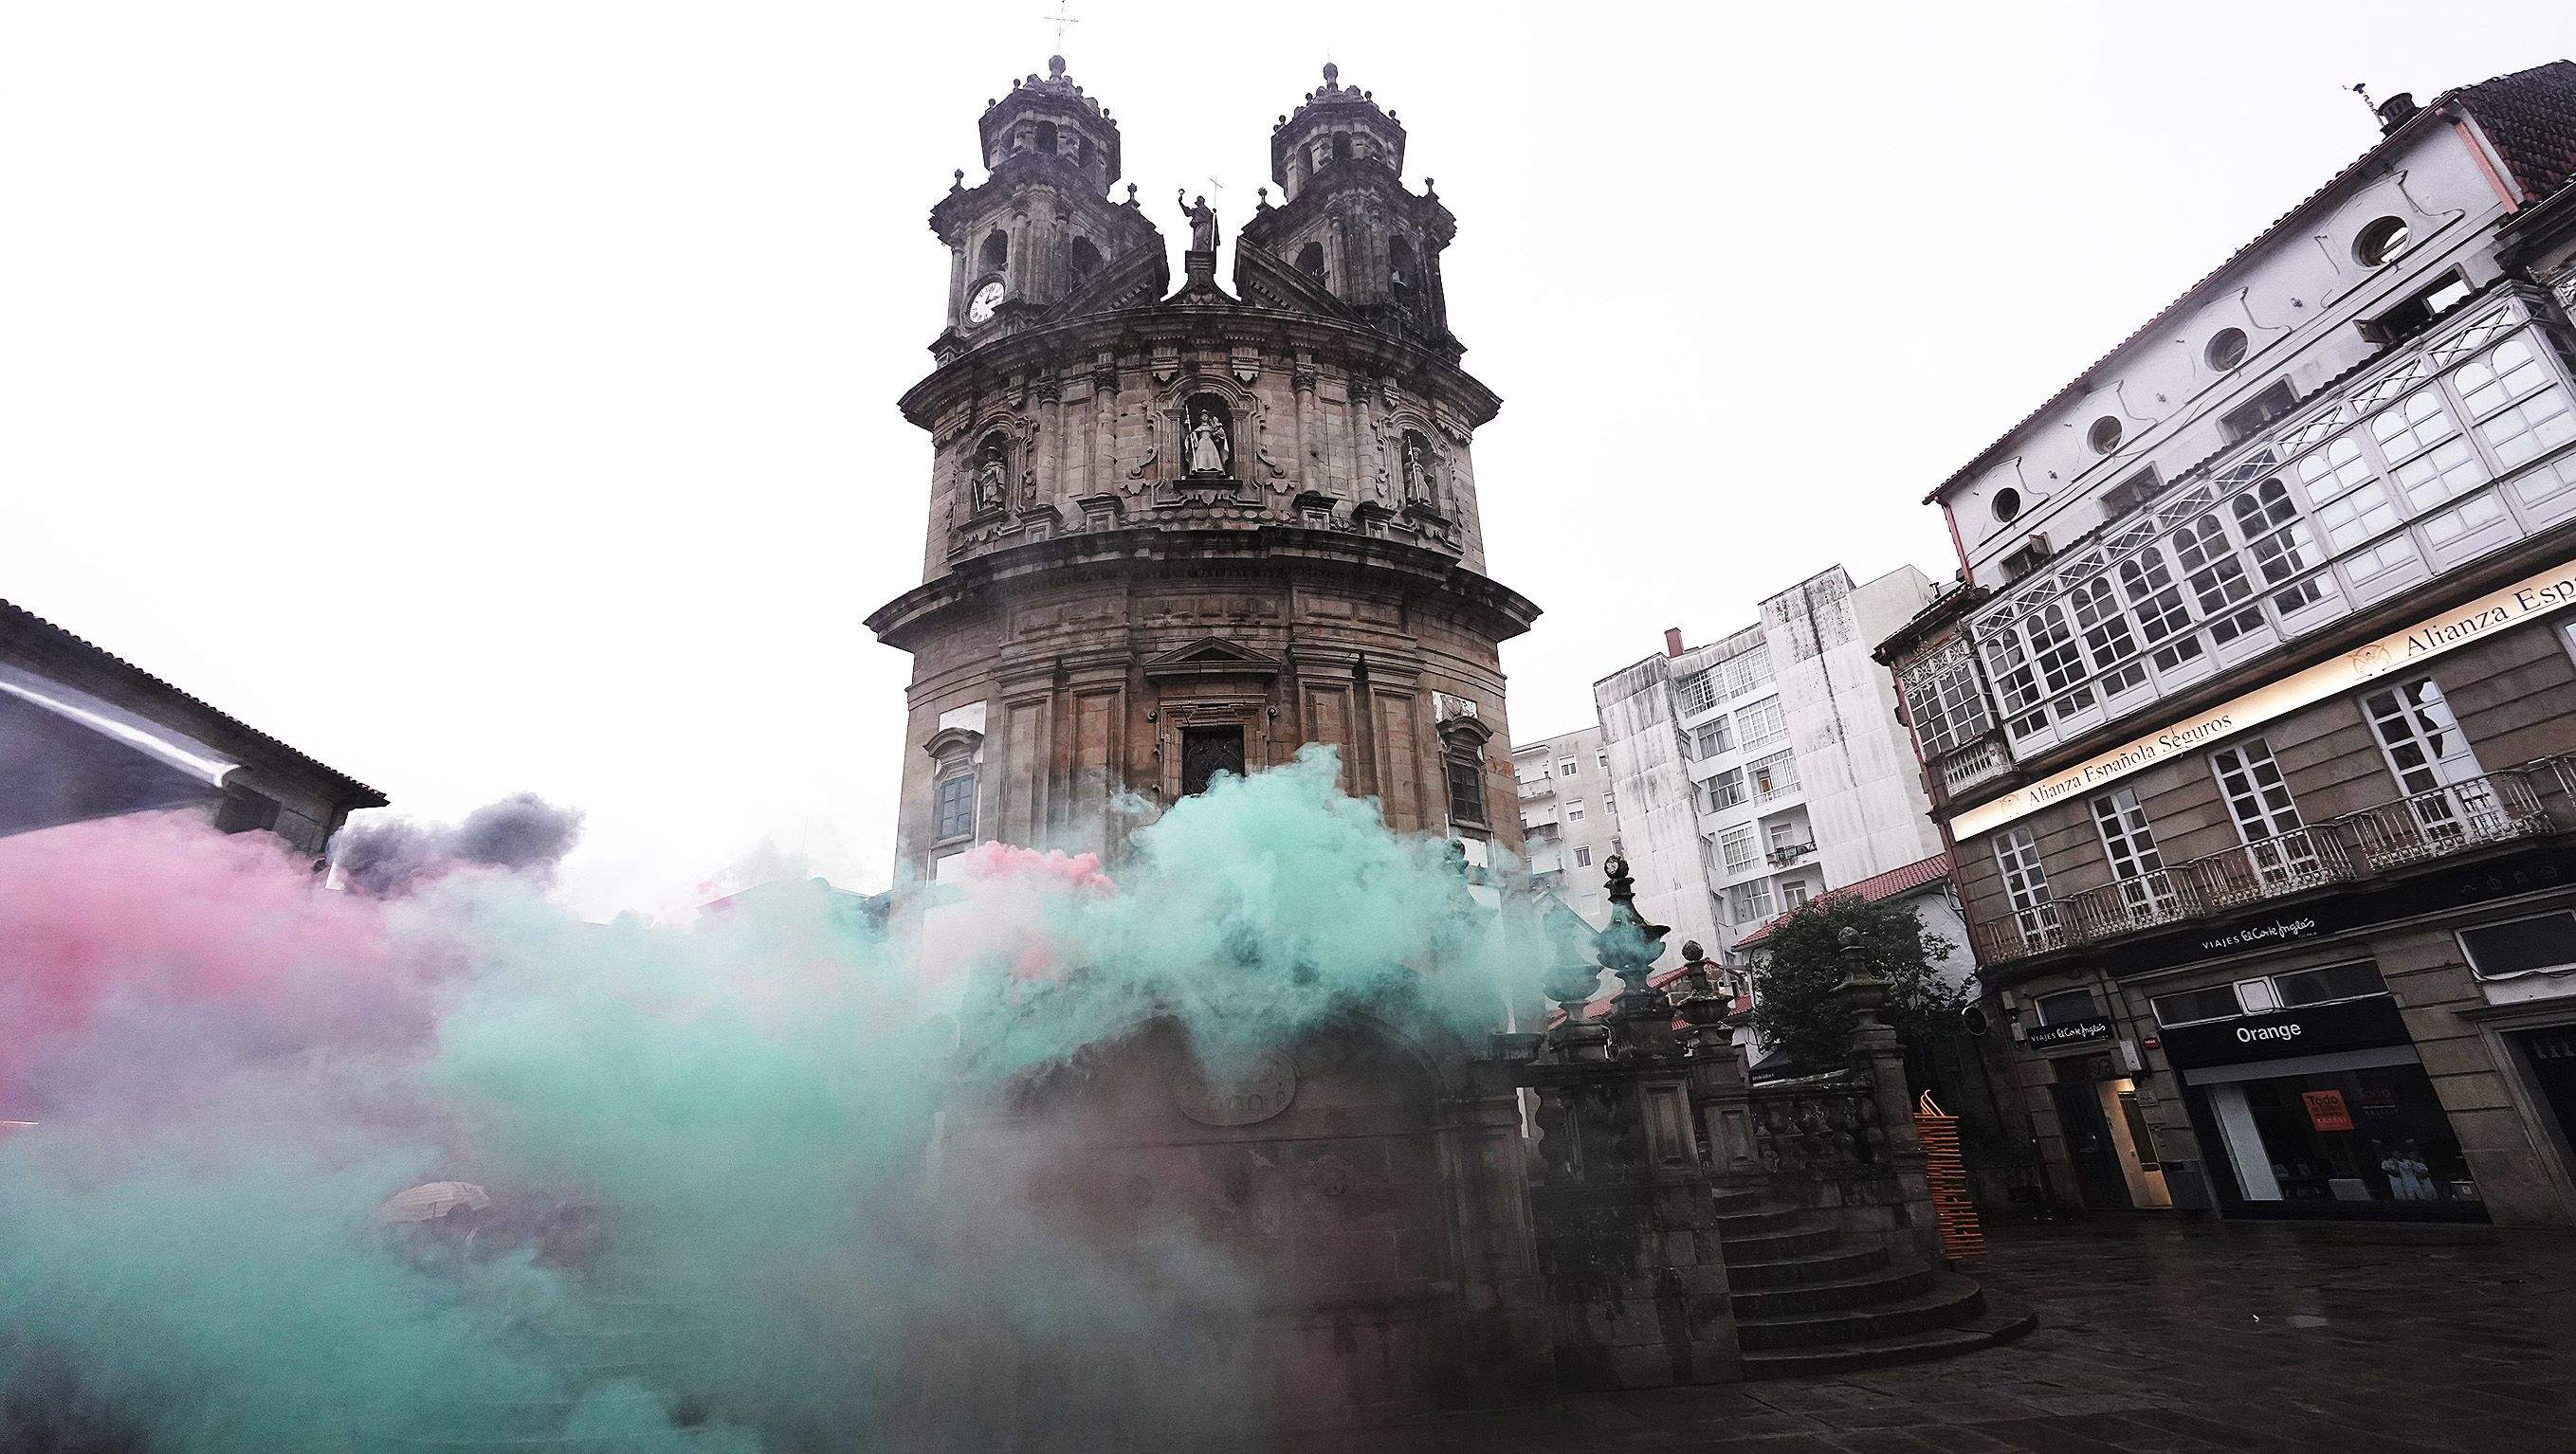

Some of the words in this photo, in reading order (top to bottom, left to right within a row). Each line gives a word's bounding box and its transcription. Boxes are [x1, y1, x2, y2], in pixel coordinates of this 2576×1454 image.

[2408, 606, 2510, 656] Alianza
[2513, 577, 2576, 611] Esp
[2029, 776, 2081, 806] Alianza
[2084, 745, 2156, 783] Española
[2159, 715, 2232, 753] Seguros
[2201, 936, 2239, 949] VIAJES
[2241, 930, 2253, 941] El
[2253, 927, 2277, 938] Corte
[2275, 918, 2314, 937] Inglés
[2031, 1032, 2055, 1042] VIAJES
[2056, 1028, 2065, 1038] El
[2064, 1027, 2081, 1037] Corte
[2237, 1024, 2302, 1043] Orange
